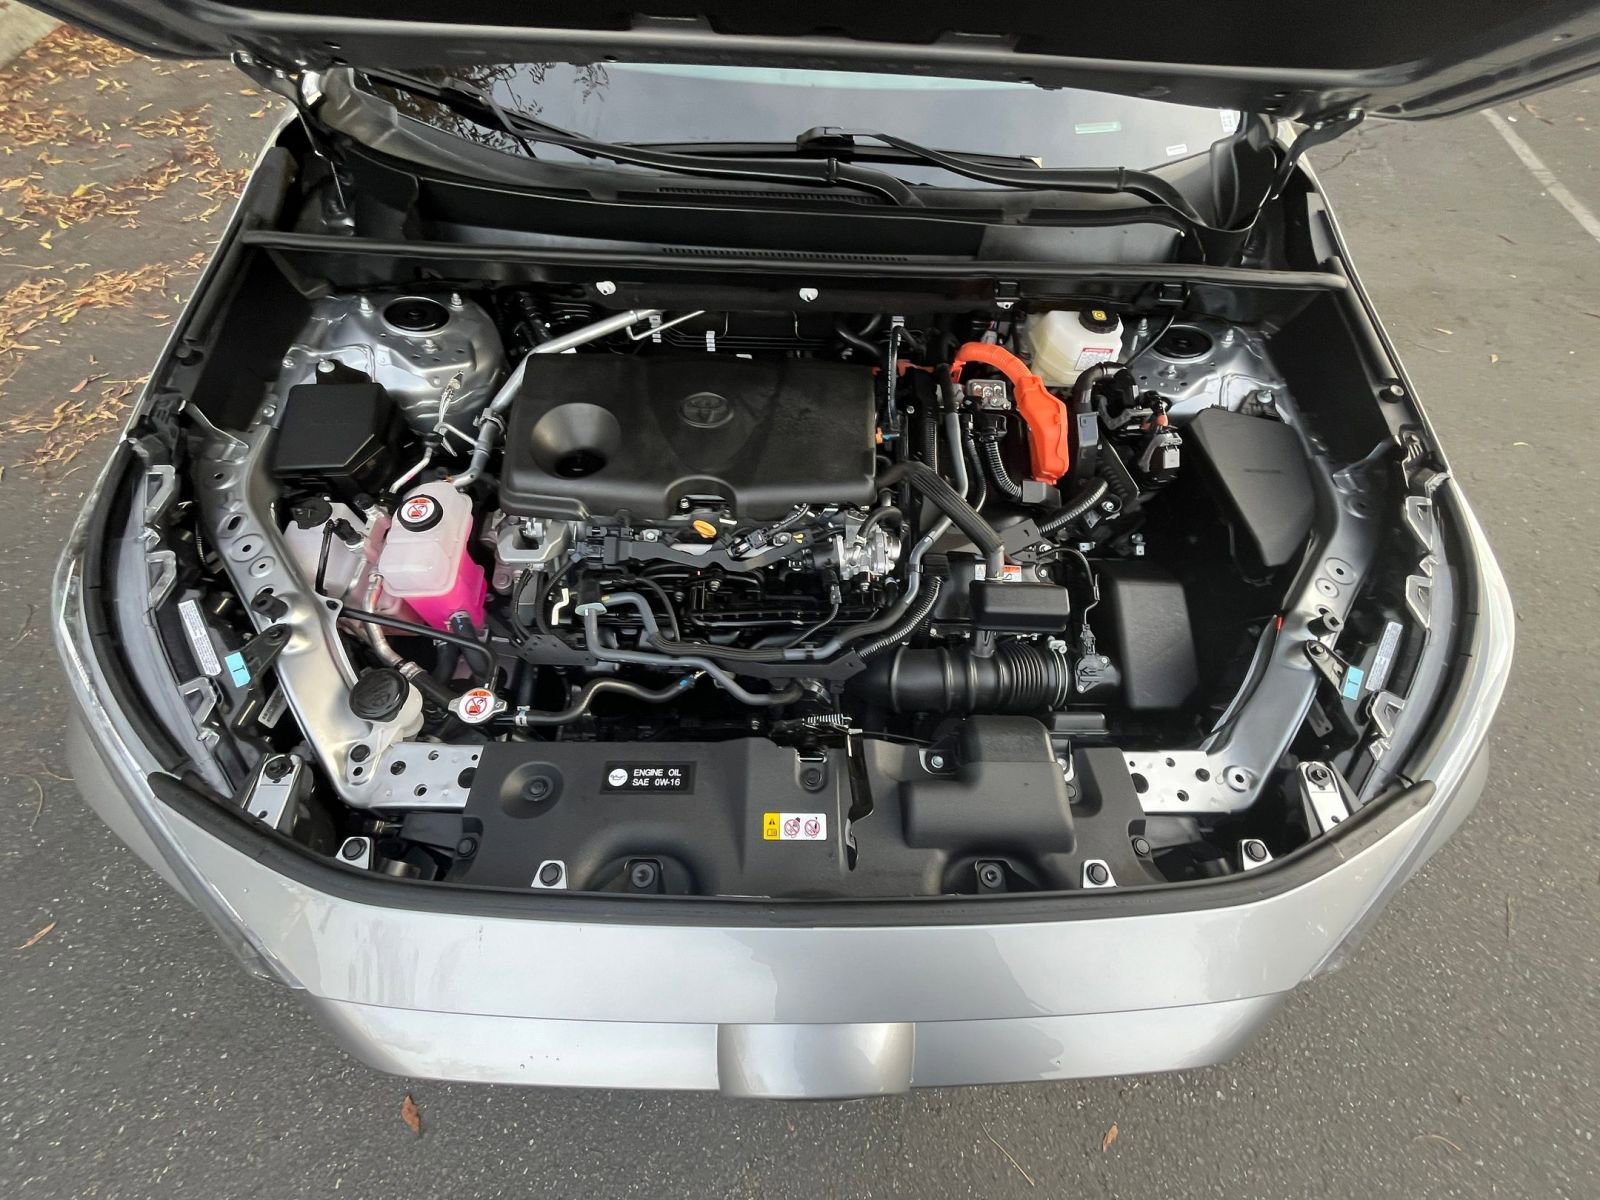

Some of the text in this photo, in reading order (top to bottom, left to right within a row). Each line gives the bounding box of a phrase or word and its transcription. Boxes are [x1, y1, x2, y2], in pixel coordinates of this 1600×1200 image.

[633, 768, 682, 776] ENGINE OIL
[632, 778, 681, 786] SAE 0W-16
